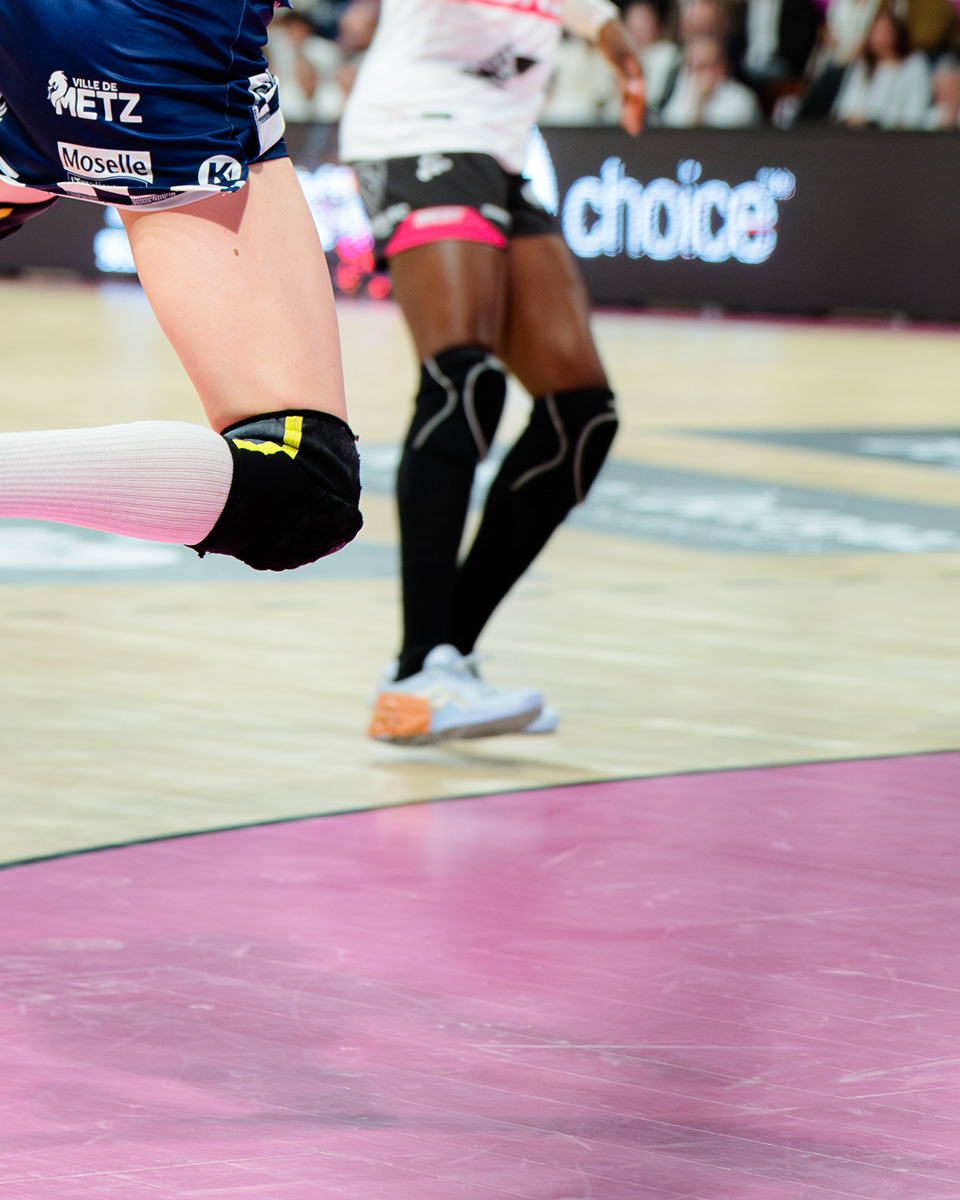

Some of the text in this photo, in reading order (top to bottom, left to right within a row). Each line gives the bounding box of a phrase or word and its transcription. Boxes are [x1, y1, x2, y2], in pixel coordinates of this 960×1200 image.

[72, 77, 118, 92] VILLE DE
[55, 87, 143, 124] METZ
[62, 147, 149, 176] Moselle
[562, 156, 778, 264] choice
